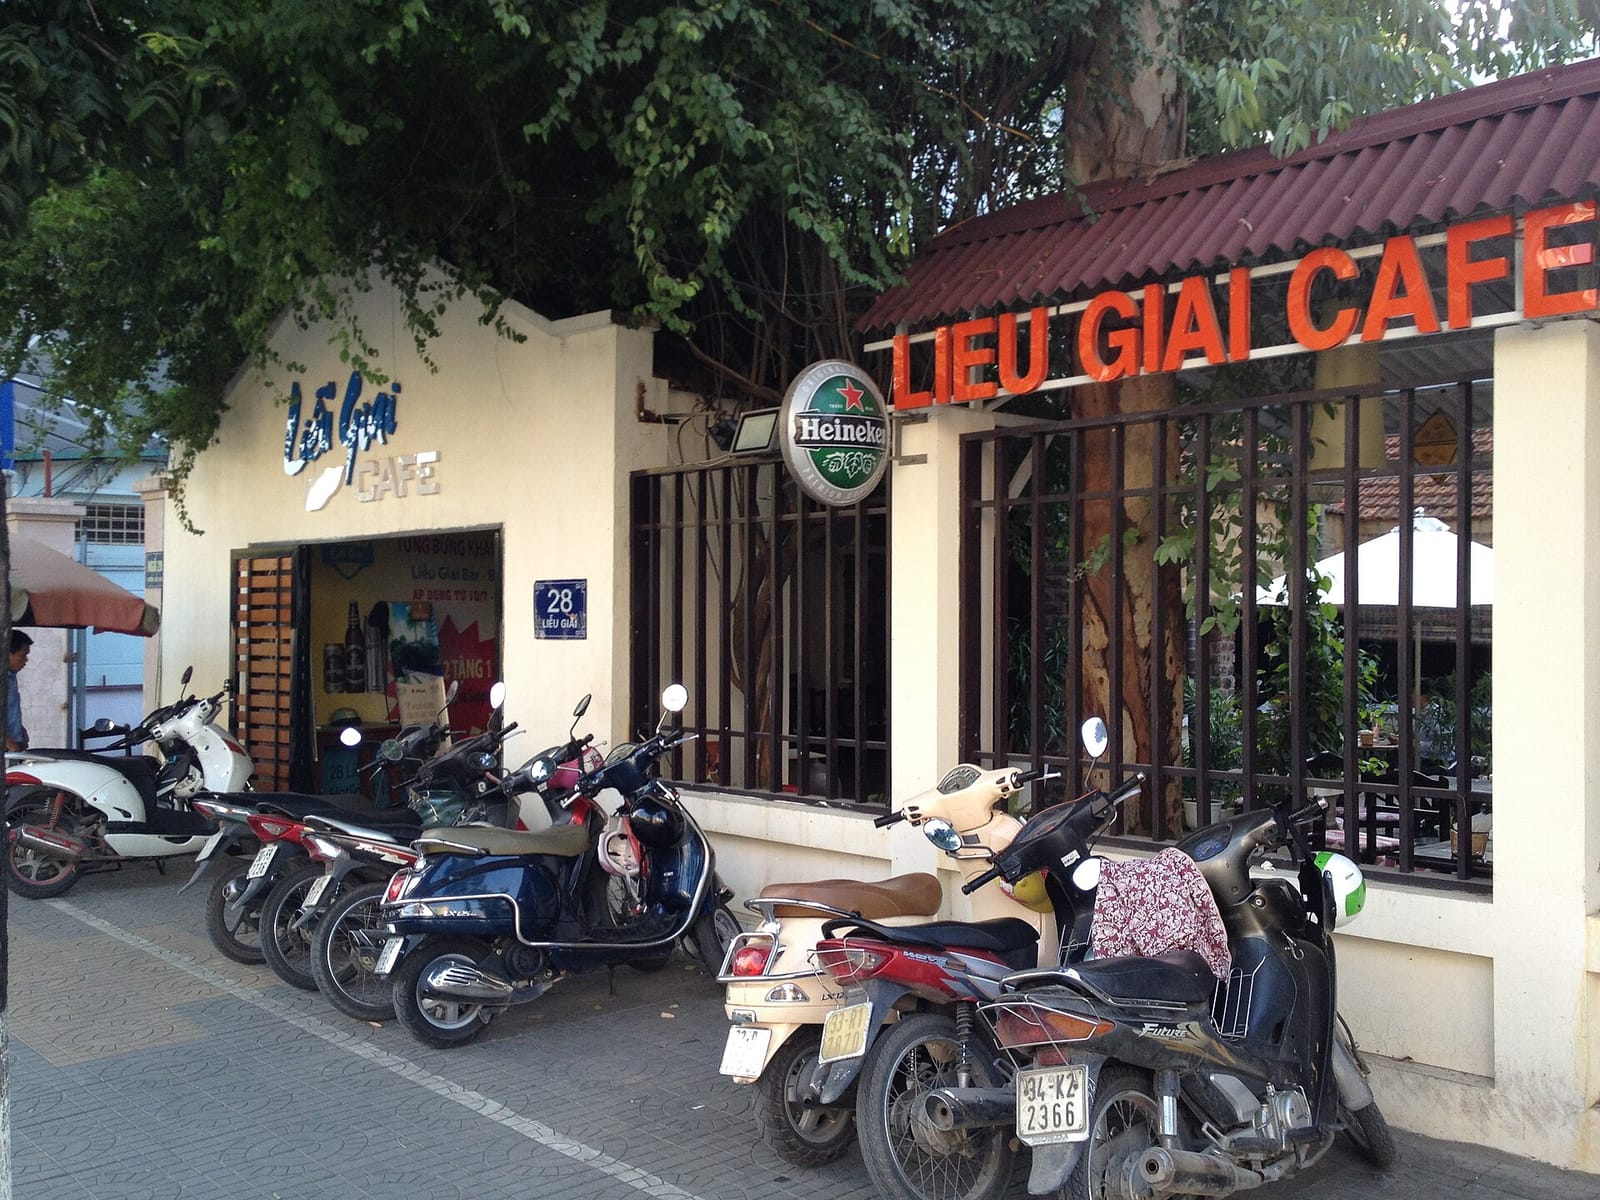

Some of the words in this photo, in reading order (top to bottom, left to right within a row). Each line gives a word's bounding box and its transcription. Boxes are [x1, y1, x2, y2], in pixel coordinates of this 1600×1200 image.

[891, 306, 1050, 410] LIEU
[1078, 266, 1252, 384] GIAI
[1286, 200, 1599, 352] CAFE
[357, 450, 441, 503] CAFE
[547, 588, 573, 613] 28
[1027, 1103, 1075, 1131] 2366
